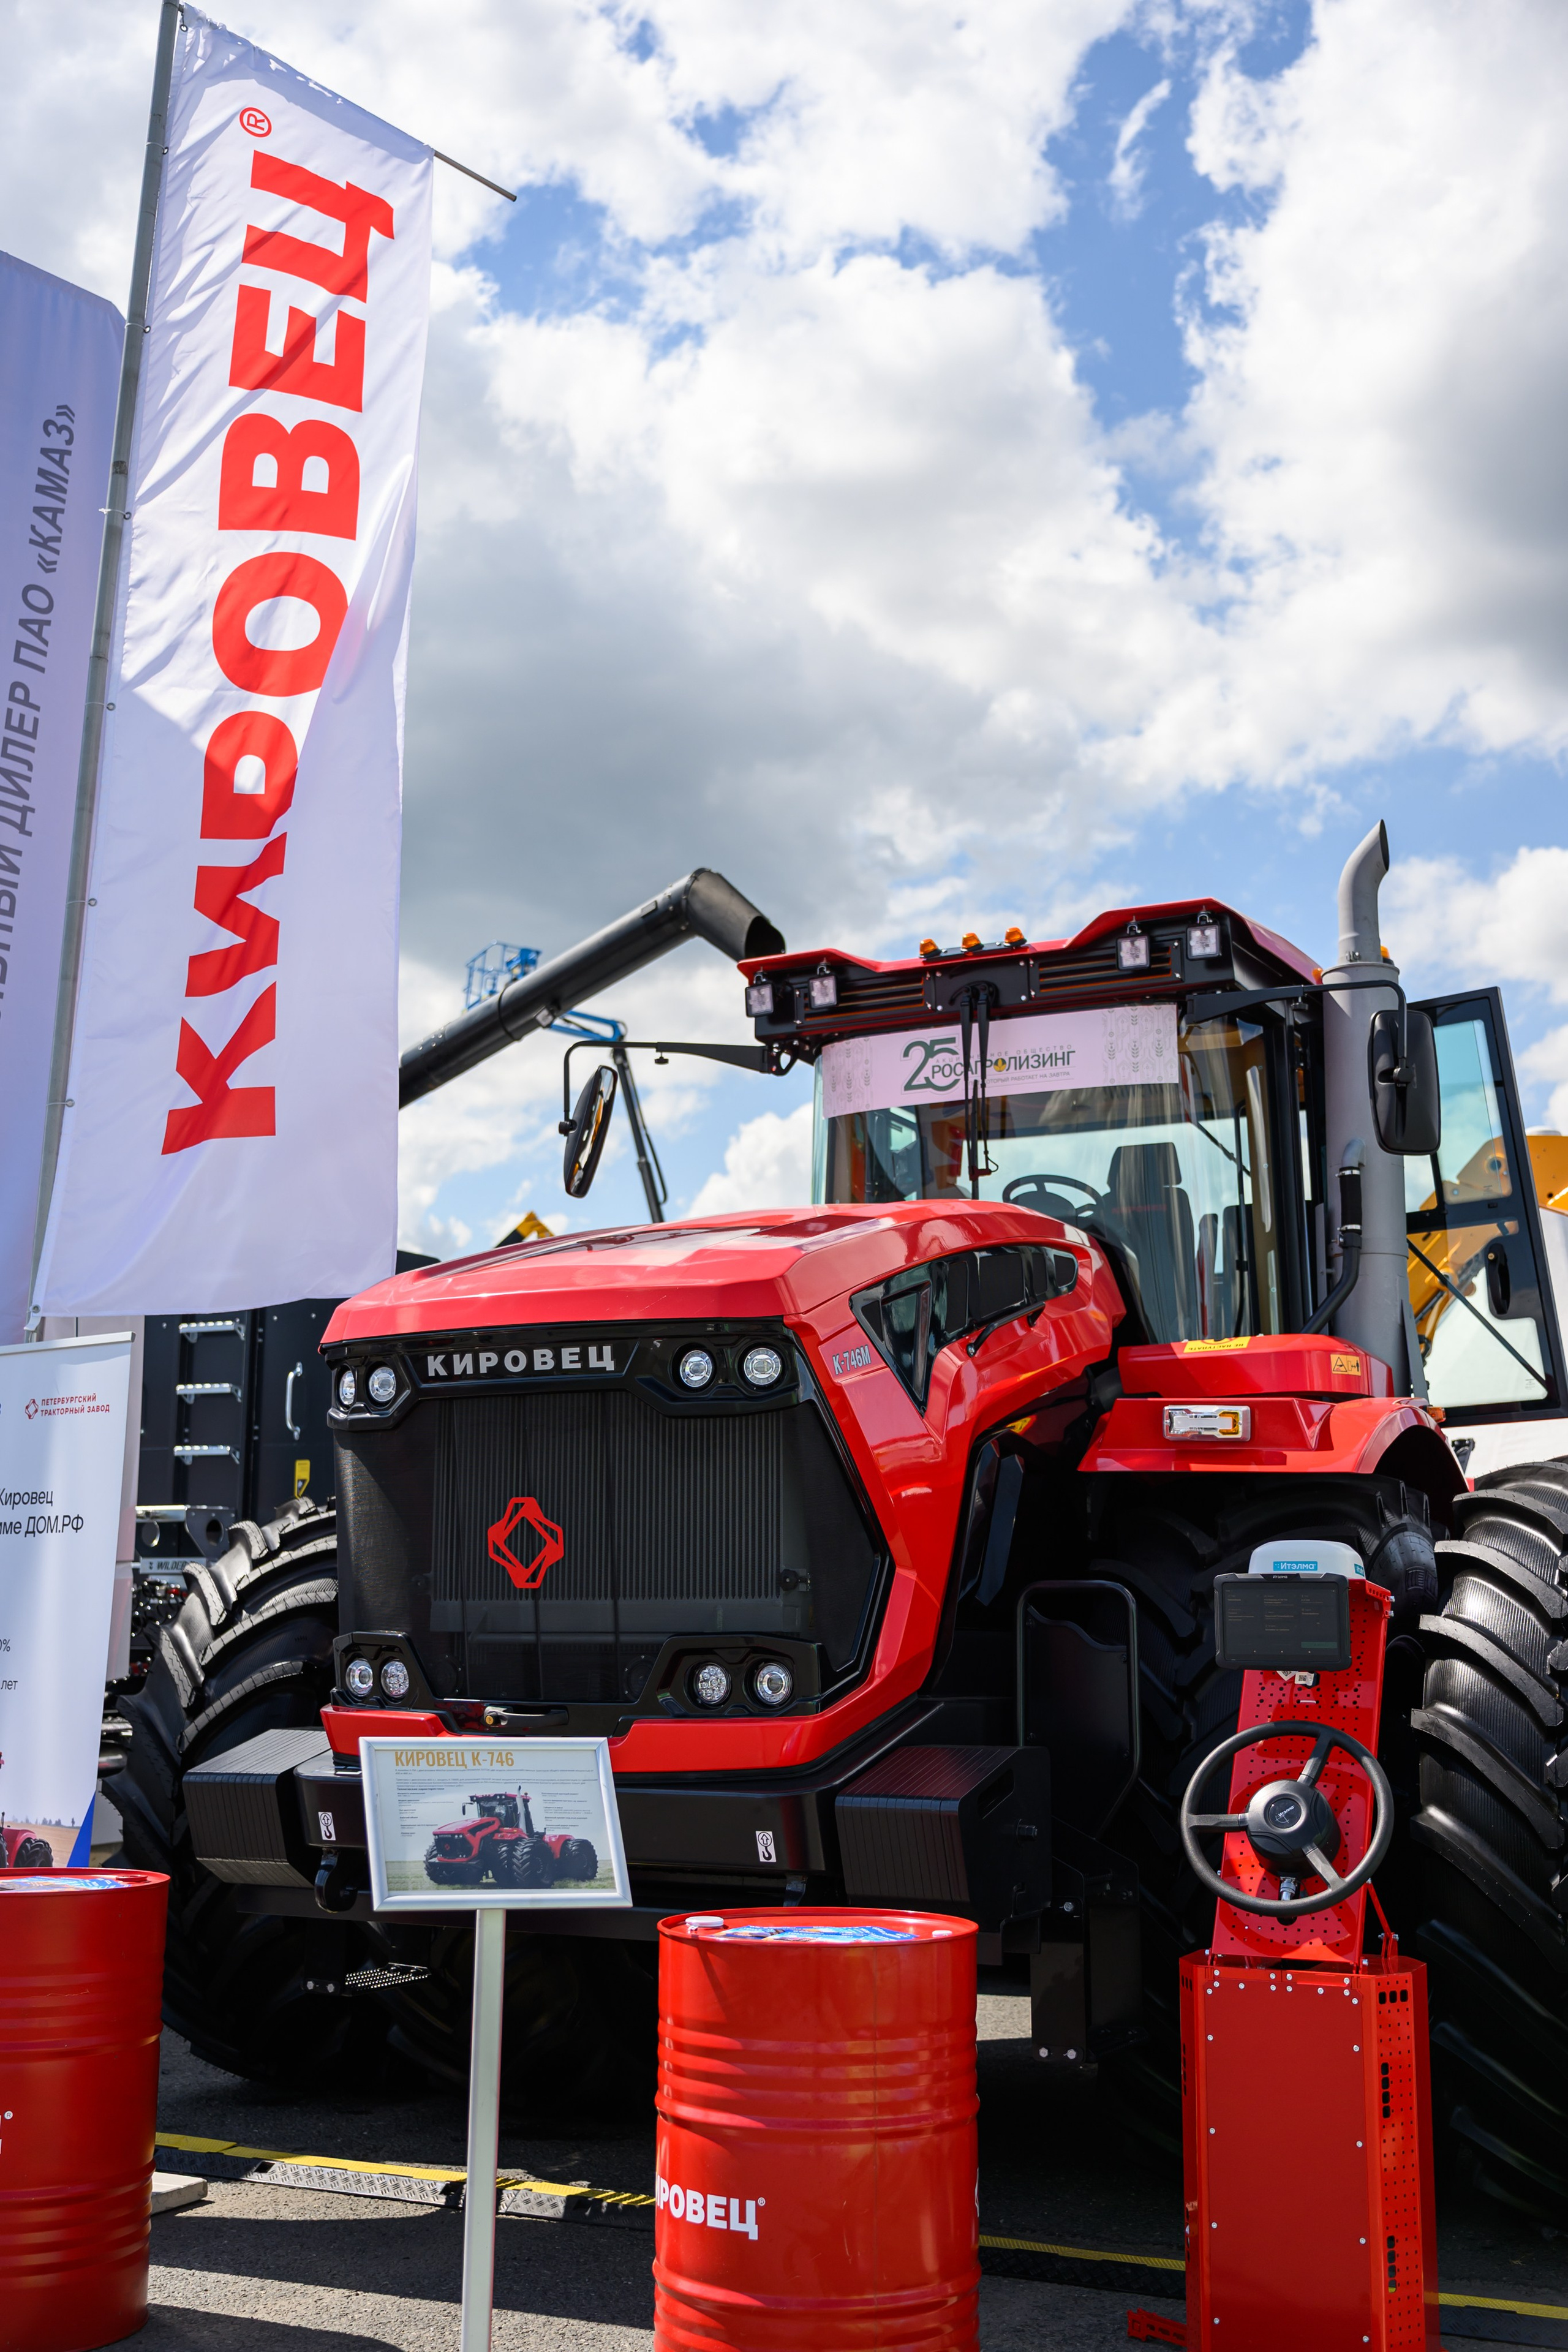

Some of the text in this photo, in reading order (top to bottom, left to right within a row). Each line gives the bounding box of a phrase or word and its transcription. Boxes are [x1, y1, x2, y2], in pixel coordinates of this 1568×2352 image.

[28, 403, 77, 575] «КАМАЗ»
[12, 582, 56, 674] ПАО
[1016, 1044, 1072, 1055] ОБЩЕСТВО
[903, 1037, 960, 1092] 25
[427, 1345, 616, 1376] КИРОВЕЦ
[41, 1393, 97, 1406] ПЕТЕРБУРГСКИЙ
[40, 1404, 110, 1417] ТРАКТОРНЫЙ ЗАВОД
[24, 1514, 84, 1538] ДОМ.РФ
[1, 1680, 18, 1691] лет
[395, 1751, 468, 1769] КИРОВЕЦ
